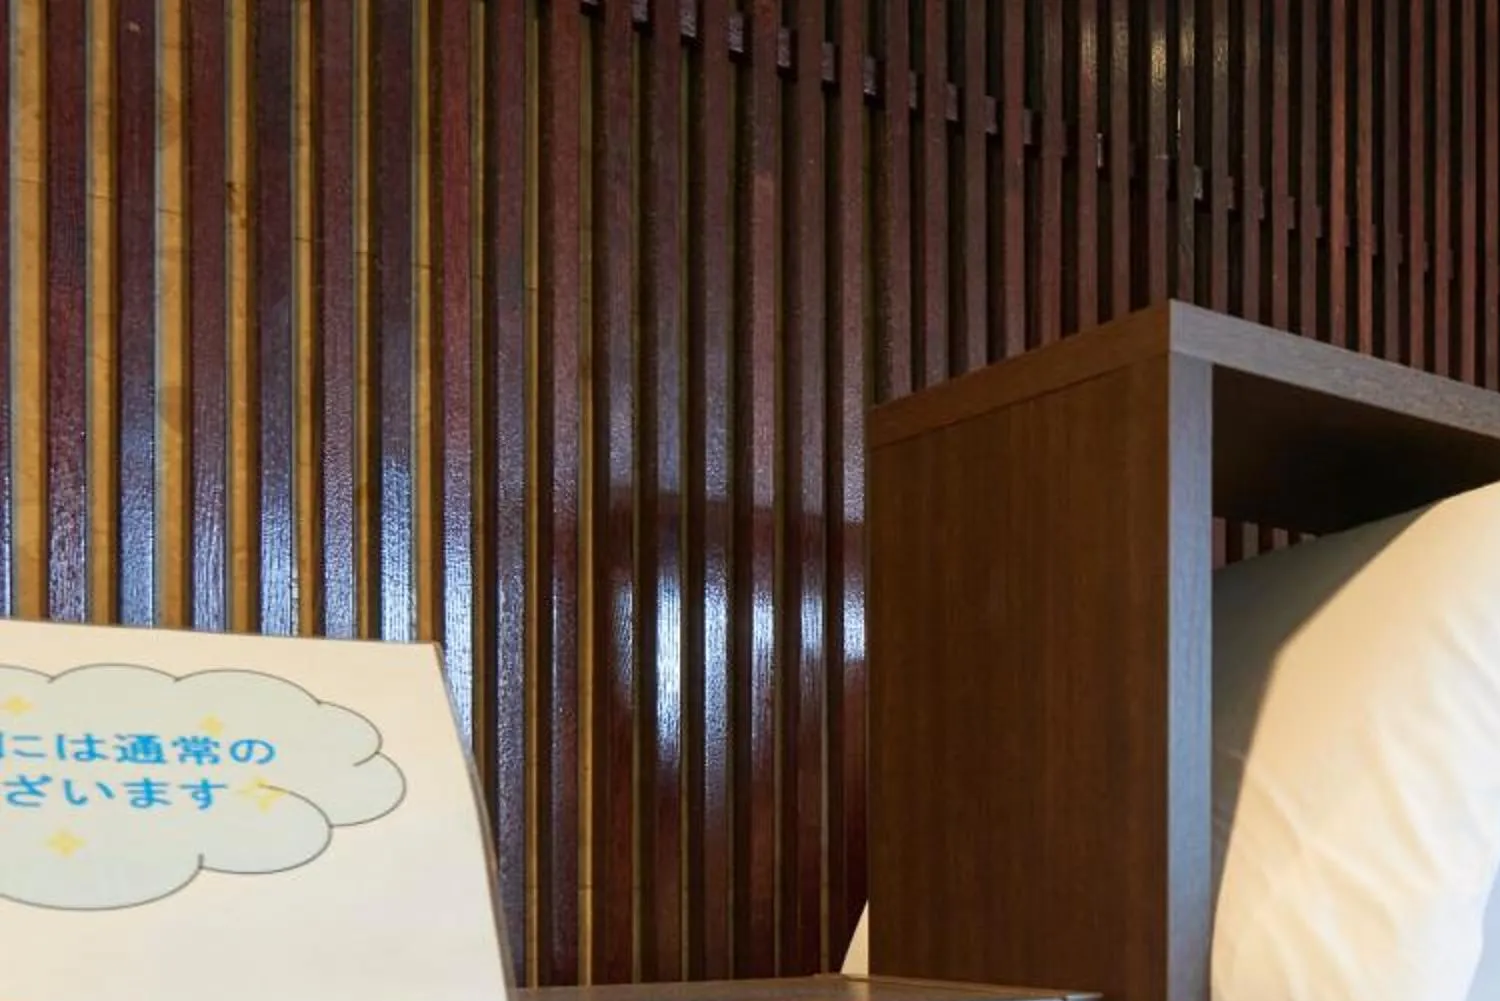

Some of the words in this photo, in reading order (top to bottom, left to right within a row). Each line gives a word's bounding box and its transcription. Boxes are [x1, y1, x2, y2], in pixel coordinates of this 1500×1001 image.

[0, 732, 276, 766] には通常の
